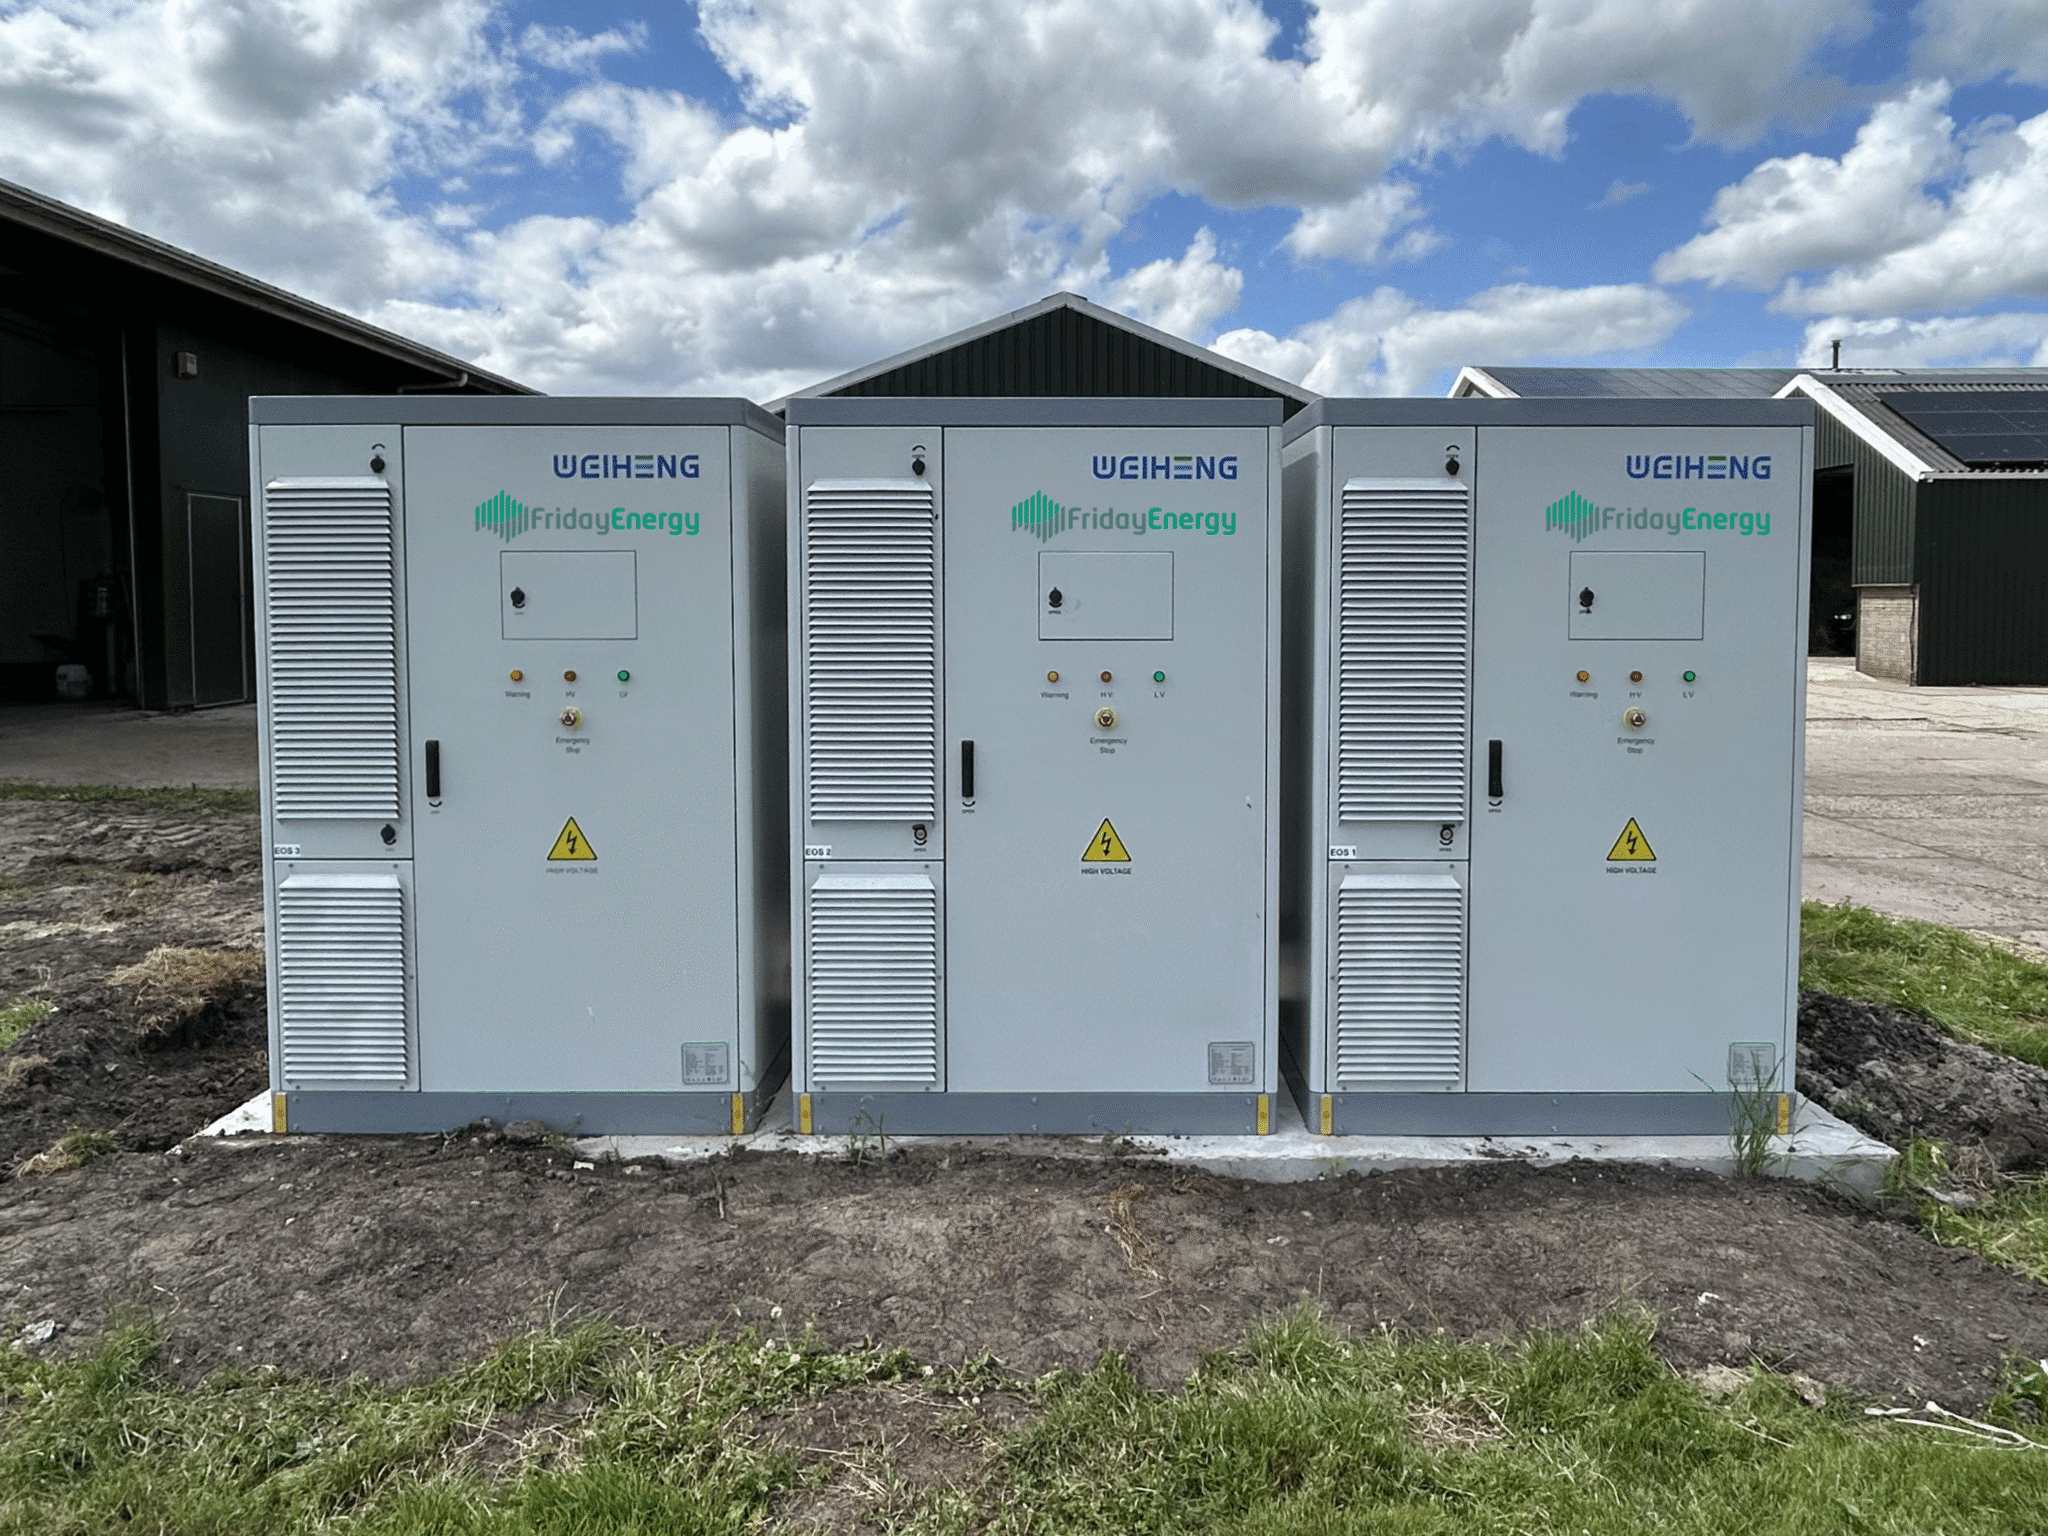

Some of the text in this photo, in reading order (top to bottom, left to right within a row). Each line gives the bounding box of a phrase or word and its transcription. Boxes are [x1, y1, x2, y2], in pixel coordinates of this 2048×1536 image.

[553, 454, 699, 479] WEIHENG
[1092, 455, 1238, 480] WEIHENG
[1626, 455, 1771, 479] WEIHENG
[531, 507, 699, 536] FridayEnergy
[1067, 507, 1236, 536] FridayEnergy
[1602, 507, 1771, 536] FridayEnergy
[504, 690, 531, 700] Warning
[1040, 691, 1069, 700] Warning
[1569, 691, 1599, 700] Warning
[555, 736, 590, 746] Emergency
[1089, 736, 1128, 746] Emergency
[1616, 737, 1655, 746] Emergency
[274, 847, 300, 855] EOS 3
[805, 848, 831, 856] EOS 2
[1330, 848, 1349, 856] EOS
[1081, 867, 1132, 875] HIGH VOLTAGE
